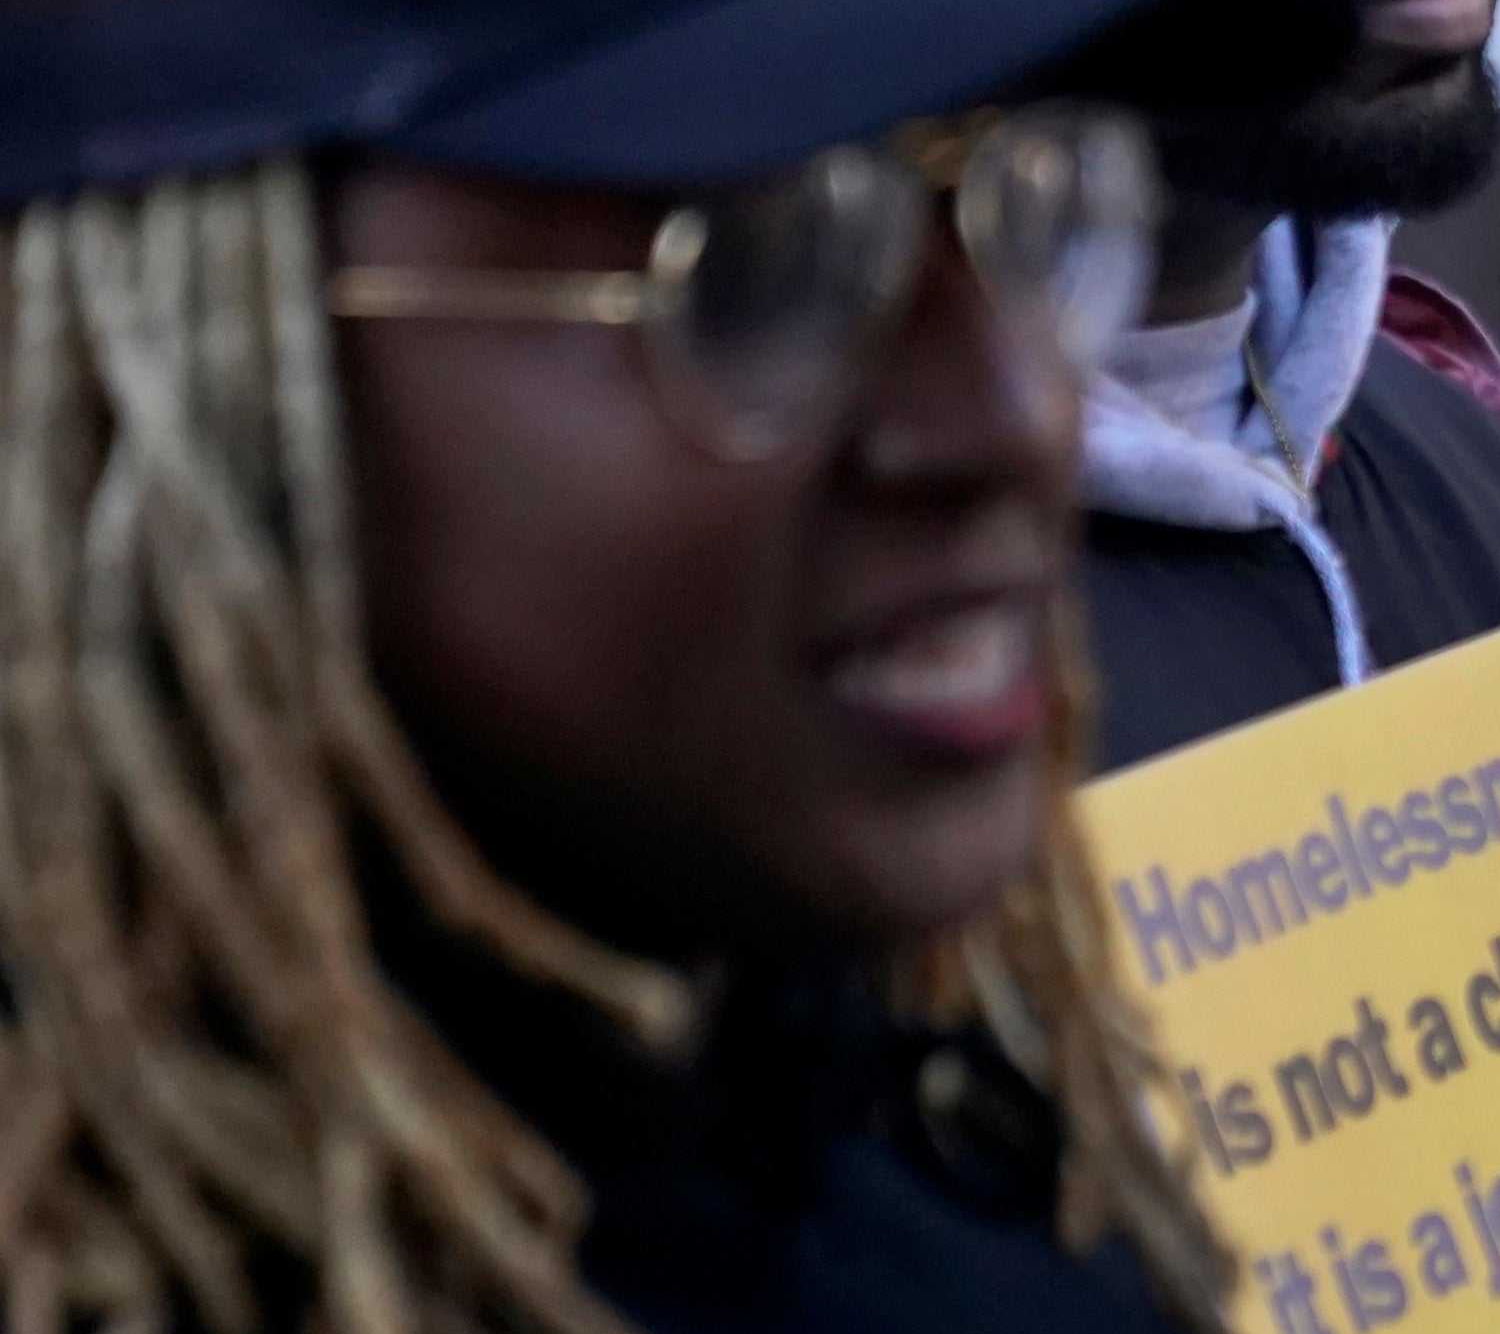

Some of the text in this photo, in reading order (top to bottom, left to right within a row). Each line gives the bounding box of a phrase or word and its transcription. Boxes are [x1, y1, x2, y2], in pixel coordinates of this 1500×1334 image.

[1275, 998, 1410, 1142] not
[1409, 997, 1467, 1083] a
[1411, 1210, 1470, 1300] a
